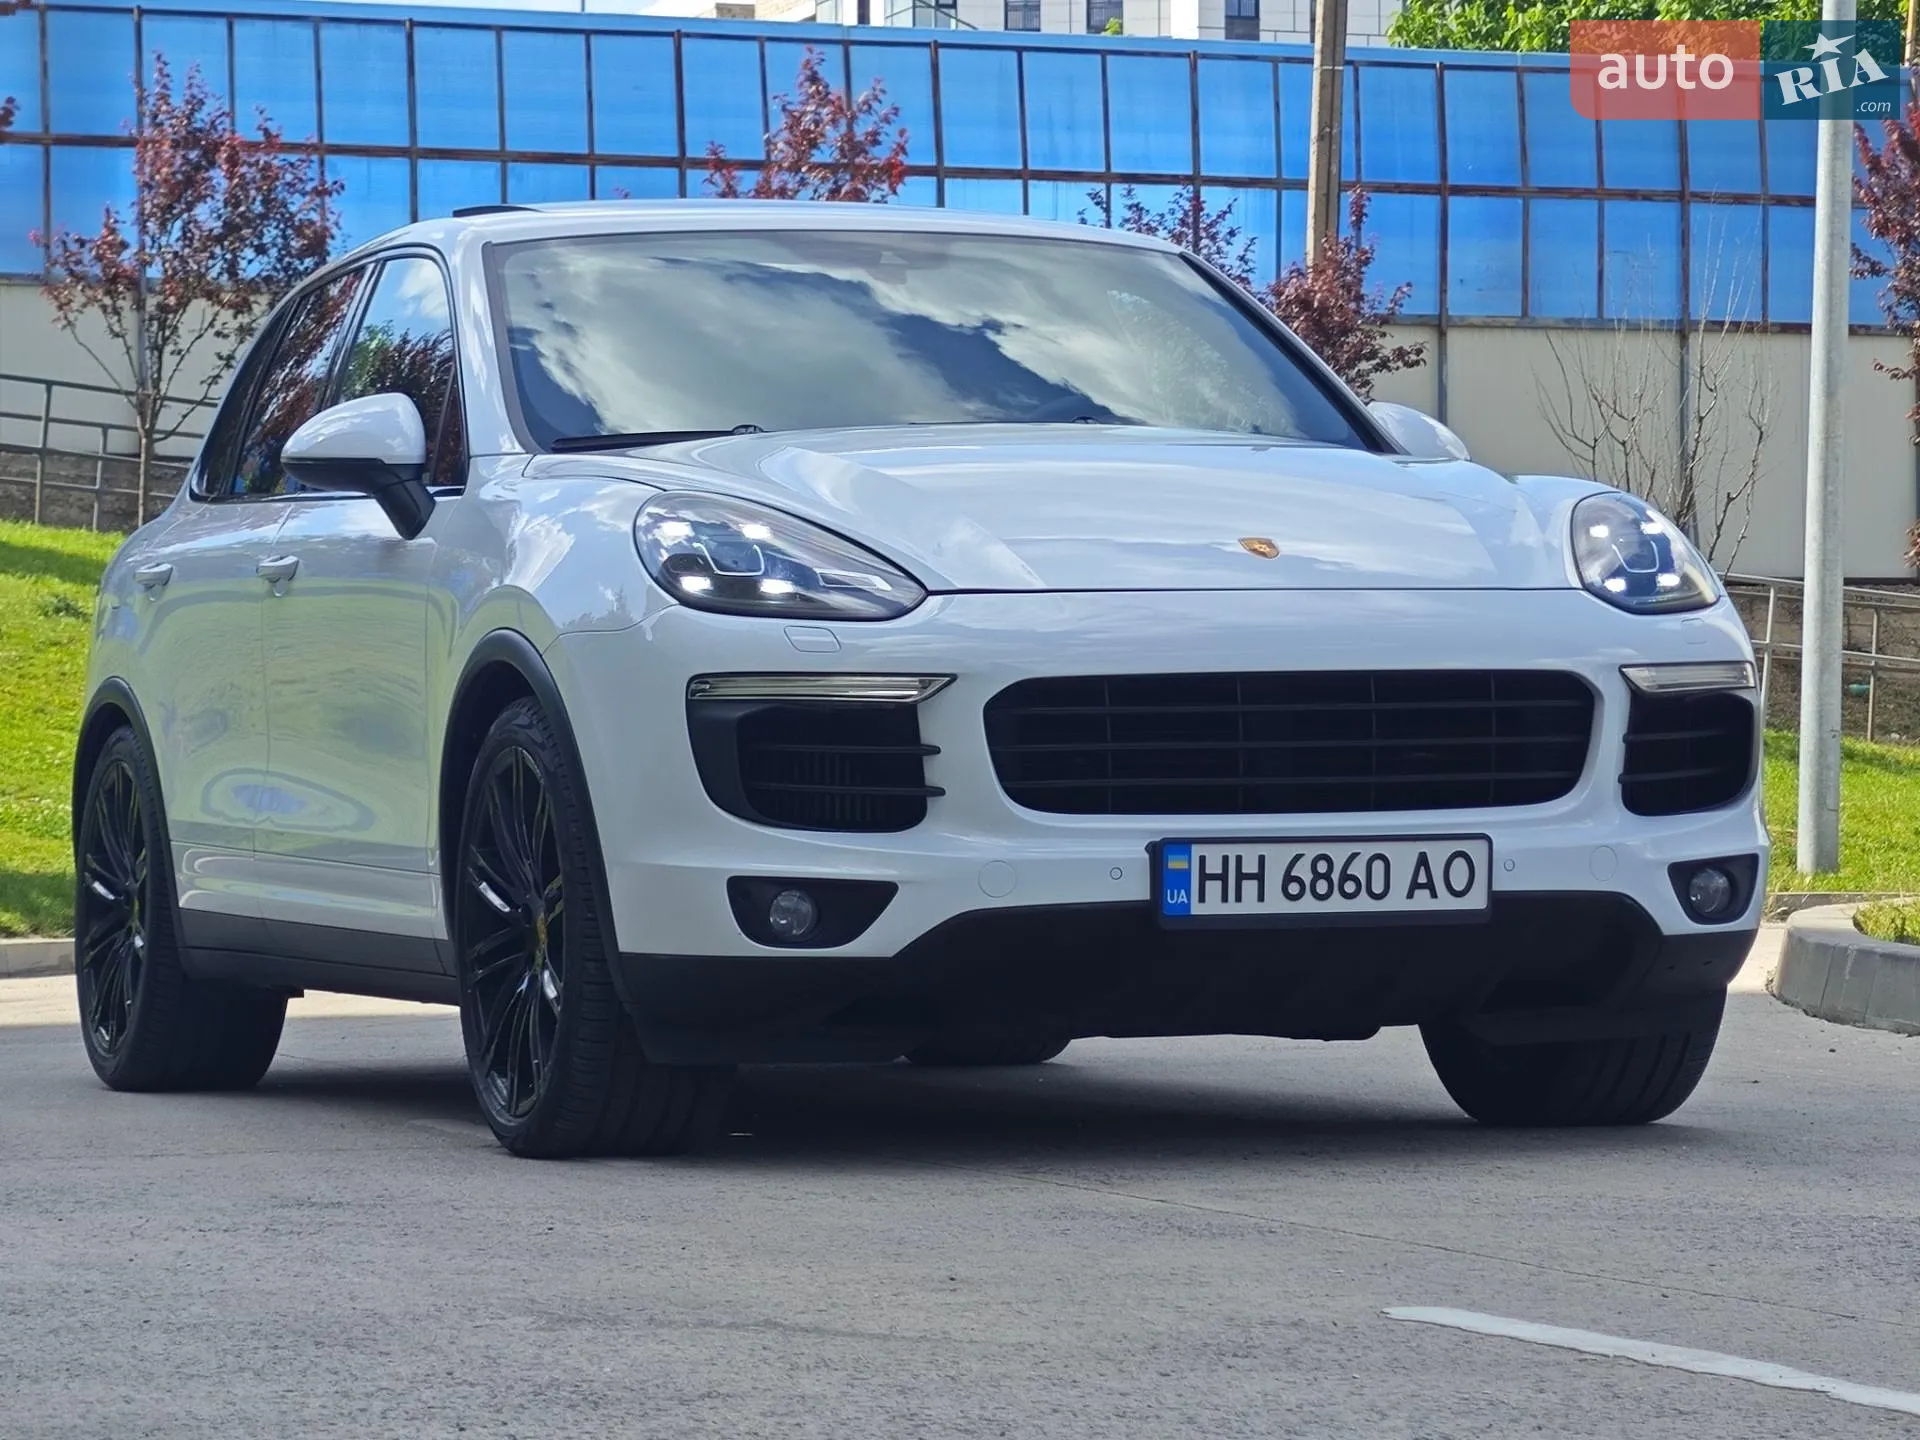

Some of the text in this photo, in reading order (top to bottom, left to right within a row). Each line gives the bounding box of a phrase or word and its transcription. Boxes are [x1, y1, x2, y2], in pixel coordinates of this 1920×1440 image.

[1198, 850, 1476, 904] HH 6860 AO
[1167, 889, 1188, 905] UA
